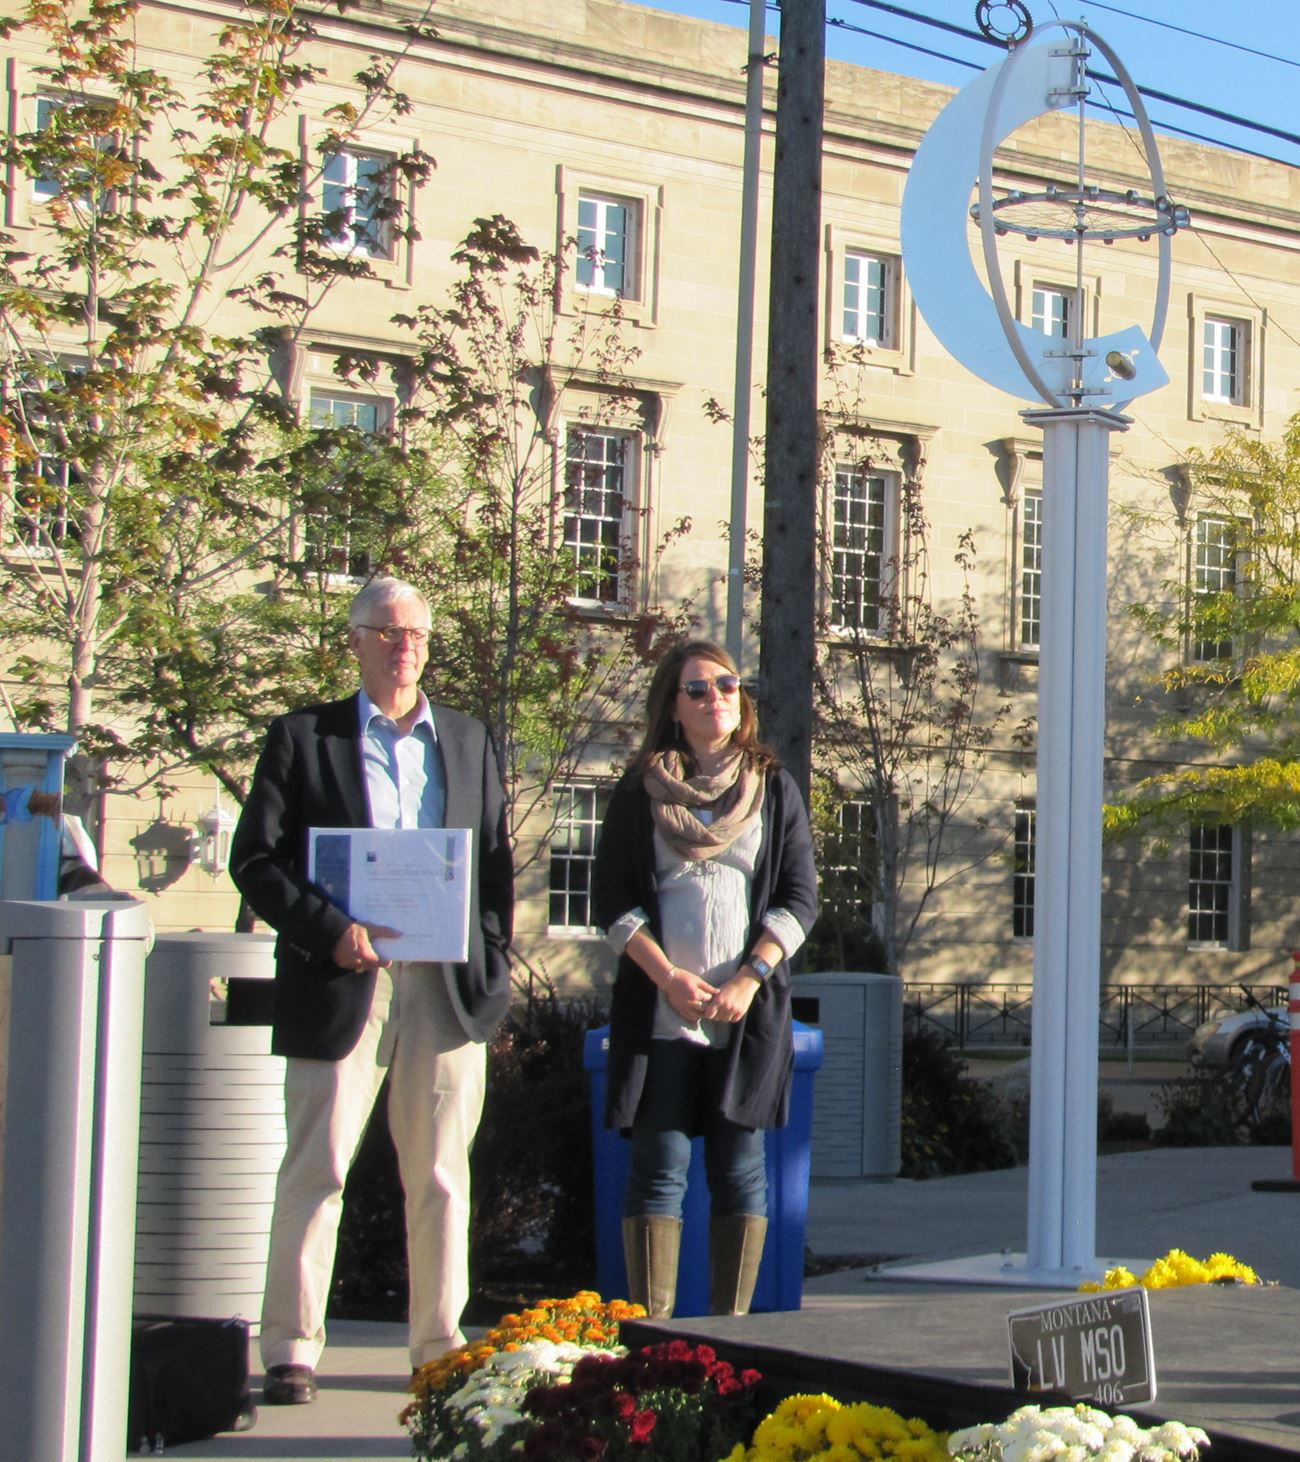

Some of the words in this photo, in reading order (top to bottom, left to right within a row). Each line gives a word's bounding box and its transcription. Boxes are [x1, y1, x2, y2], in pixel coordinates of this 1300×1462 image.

[1040, 1300, 1112, 1332] MONTANA
[1037, 1335, 1066, 1391] LV
[1080, 1324, 1126, 1383] MSO
[1094, 1381, 1124, 1406] 406
